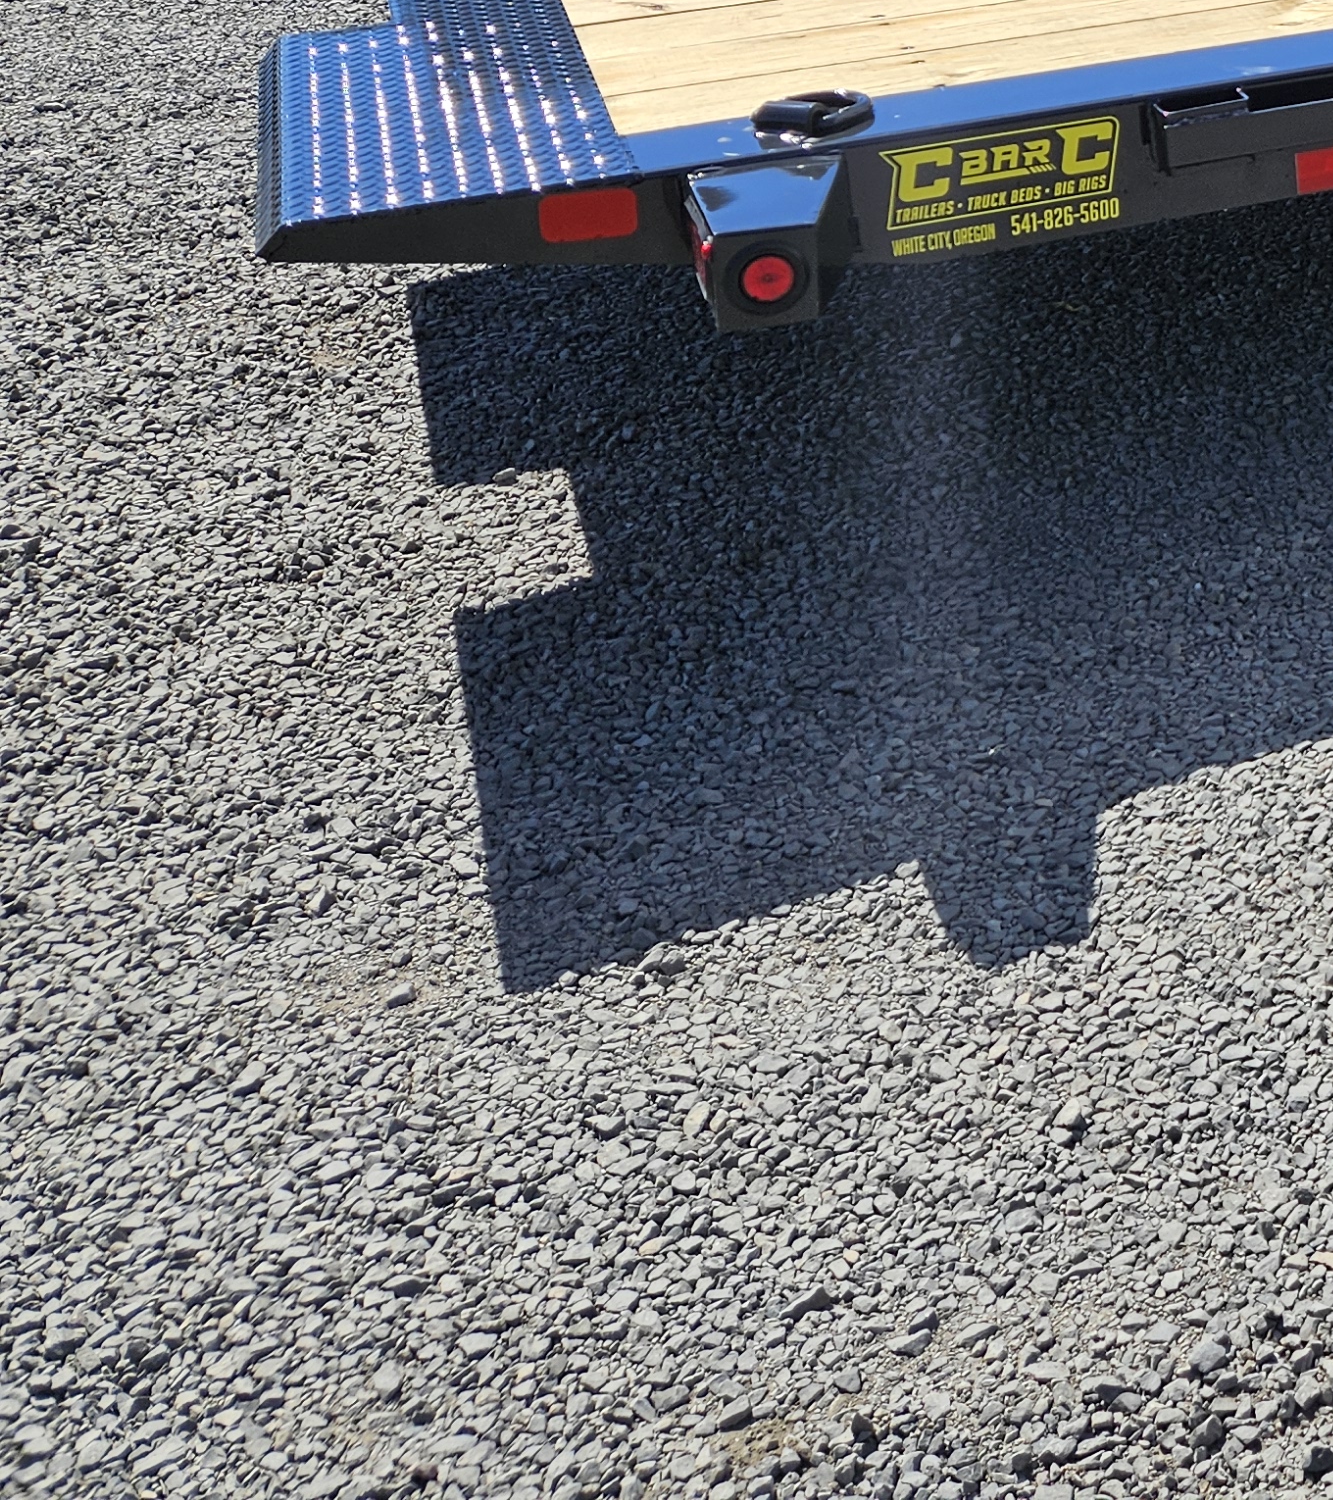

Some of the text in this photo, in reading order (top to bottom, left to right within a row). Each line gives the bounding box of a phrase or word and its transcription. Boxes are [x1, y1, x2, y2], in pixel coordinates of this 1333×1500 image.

[891, 121, 1114, 203] C BAR C
[895, 174, 1107, 224] TRAILERS TRUCK BEDS BIG RIGS
[1010, 197, 1120, 237] 541-826-5600
[891, 222, 997, 257] WHITE CITY, OREGON
